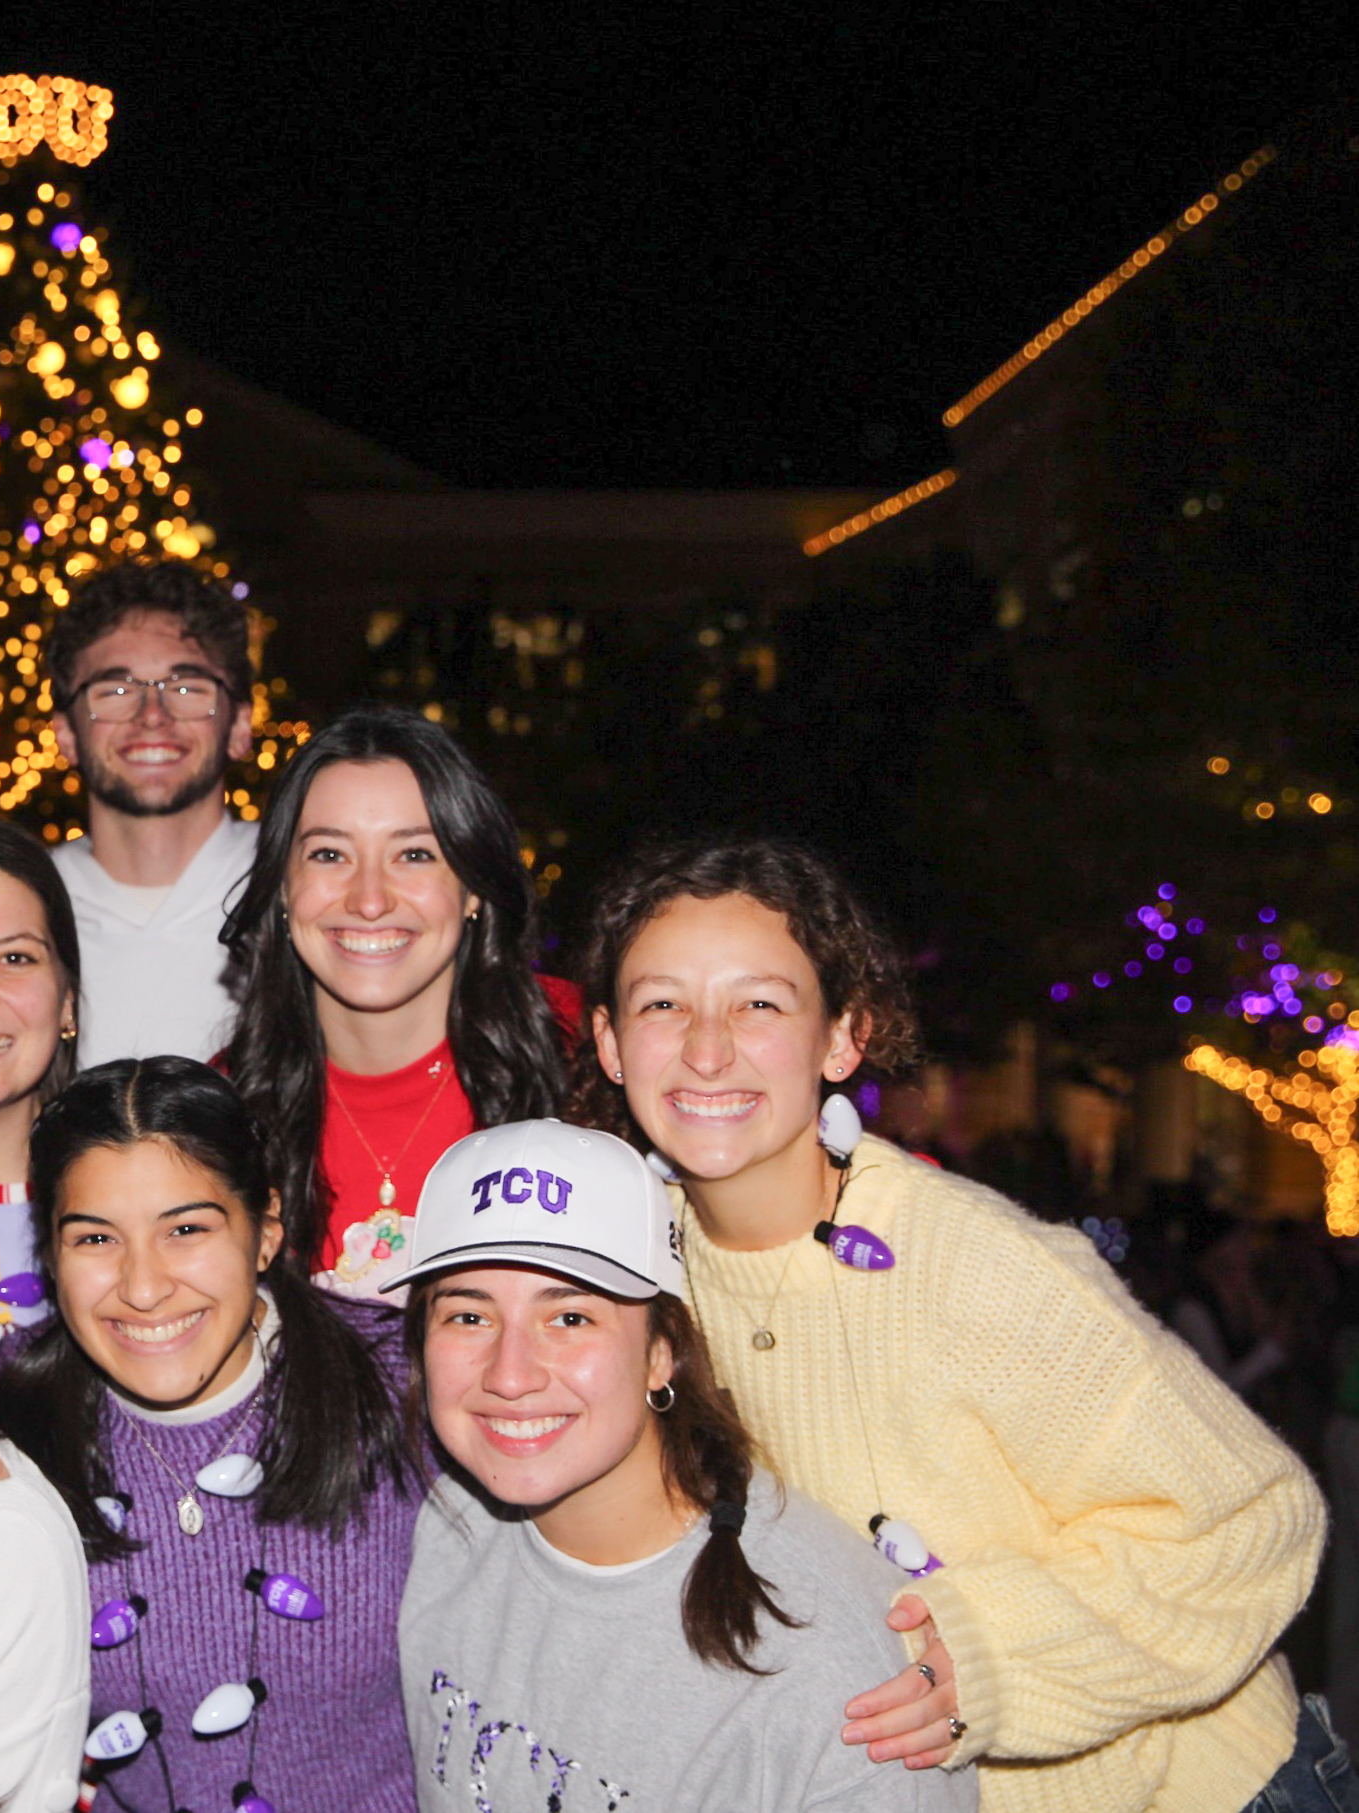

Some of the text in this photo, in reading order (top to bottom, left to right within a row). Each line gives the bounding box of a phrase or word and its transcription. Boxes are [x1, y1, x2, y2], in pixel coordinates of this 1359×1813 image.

[471, 1167, 572, 1215] TCU
[268, 1578, 290, 1609] TCU
[114, 1721, 133, 1749] TCU
